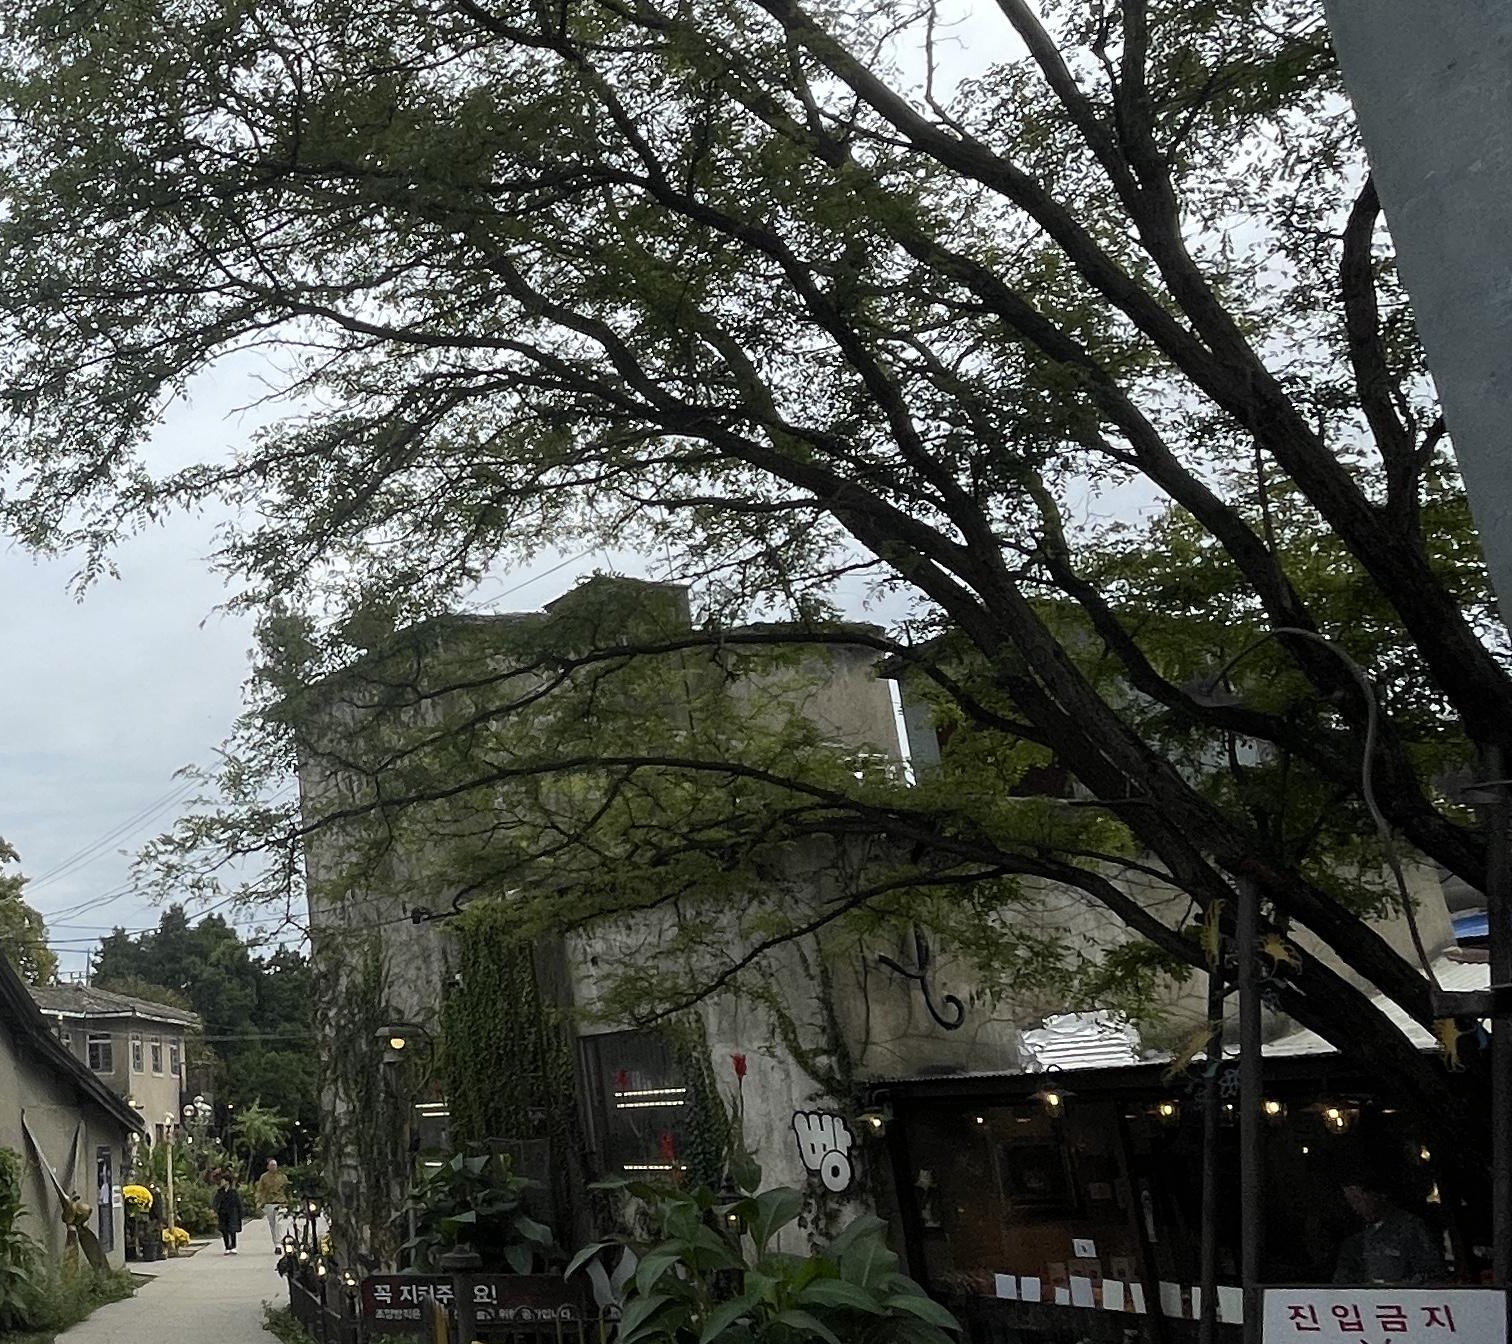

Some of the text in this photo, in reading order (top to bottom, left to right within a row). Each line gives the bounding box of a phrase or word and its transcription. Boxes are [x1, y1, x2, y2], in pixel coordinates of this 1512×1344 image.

[792, 1111, 856, 1193] 빵
[373, 1284, 393, 1304] 꼭
[1287, 1304, 1456, 1333] 진입금지
